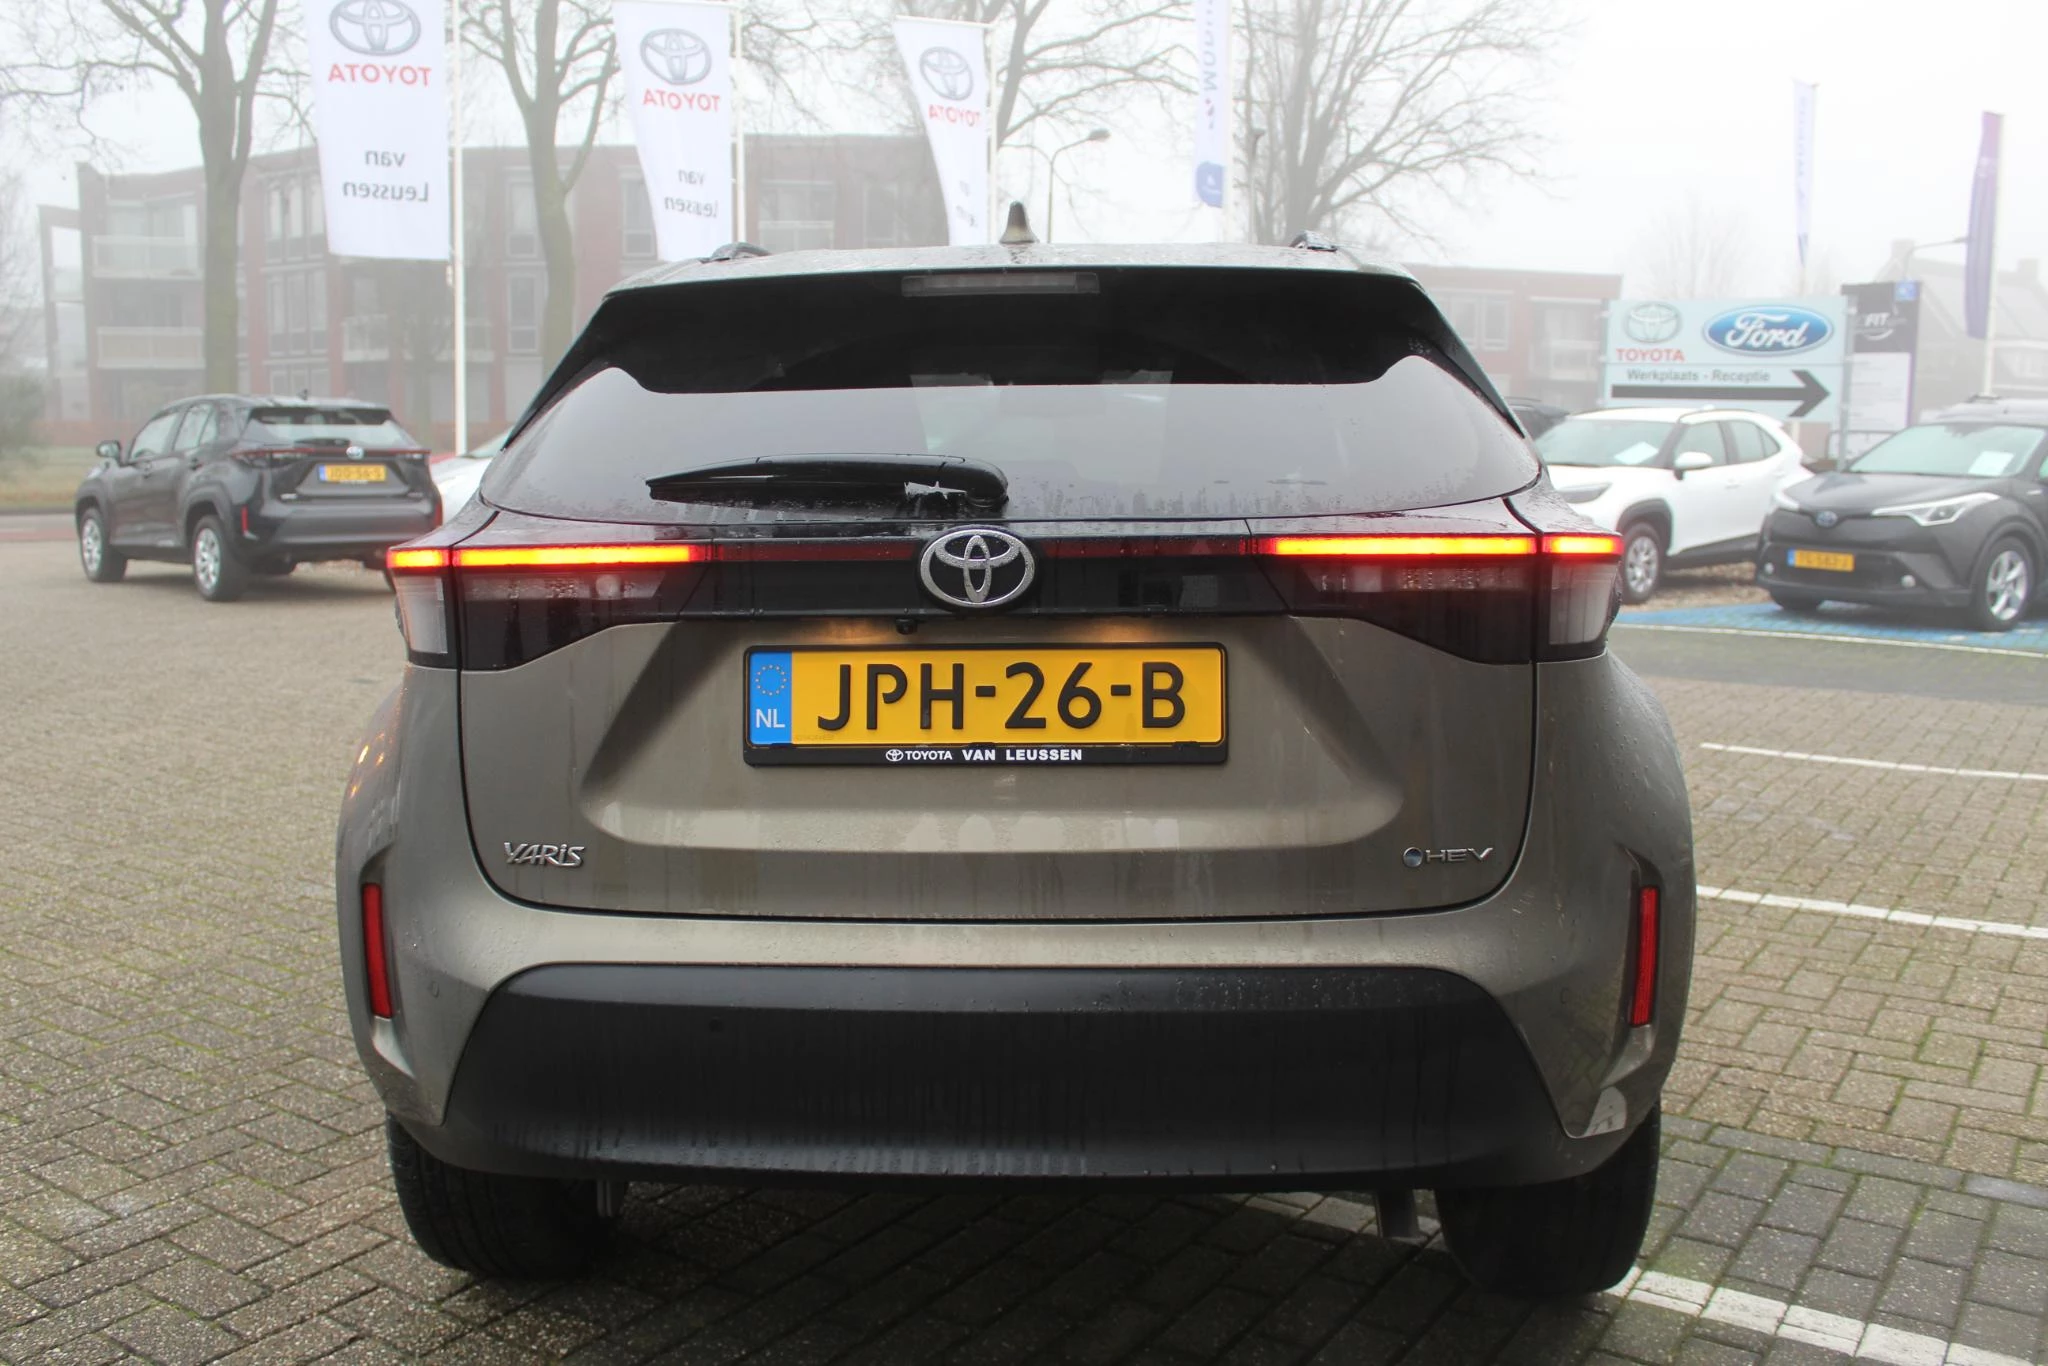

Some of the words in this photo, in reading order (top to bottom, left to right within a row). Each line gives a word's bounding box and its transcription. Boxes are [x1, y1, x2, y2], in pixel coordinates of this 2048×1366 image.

[1725, 312, 1808, 347] Ford
[1616, 348, 1686, 363] TOYOTA
[1626, 368, 1699, 383] Werkplaats
[1711, 368, 1771, 383] Receptie
[755, 708, 786, 728] NL
[817, 661, 1186, 731] JPH-26-B
[905, 750, 953, 761] TOYOTA
[962, 749, 996, 761] VAN
[1006, 749, 1082, 761] LEUSSEN
